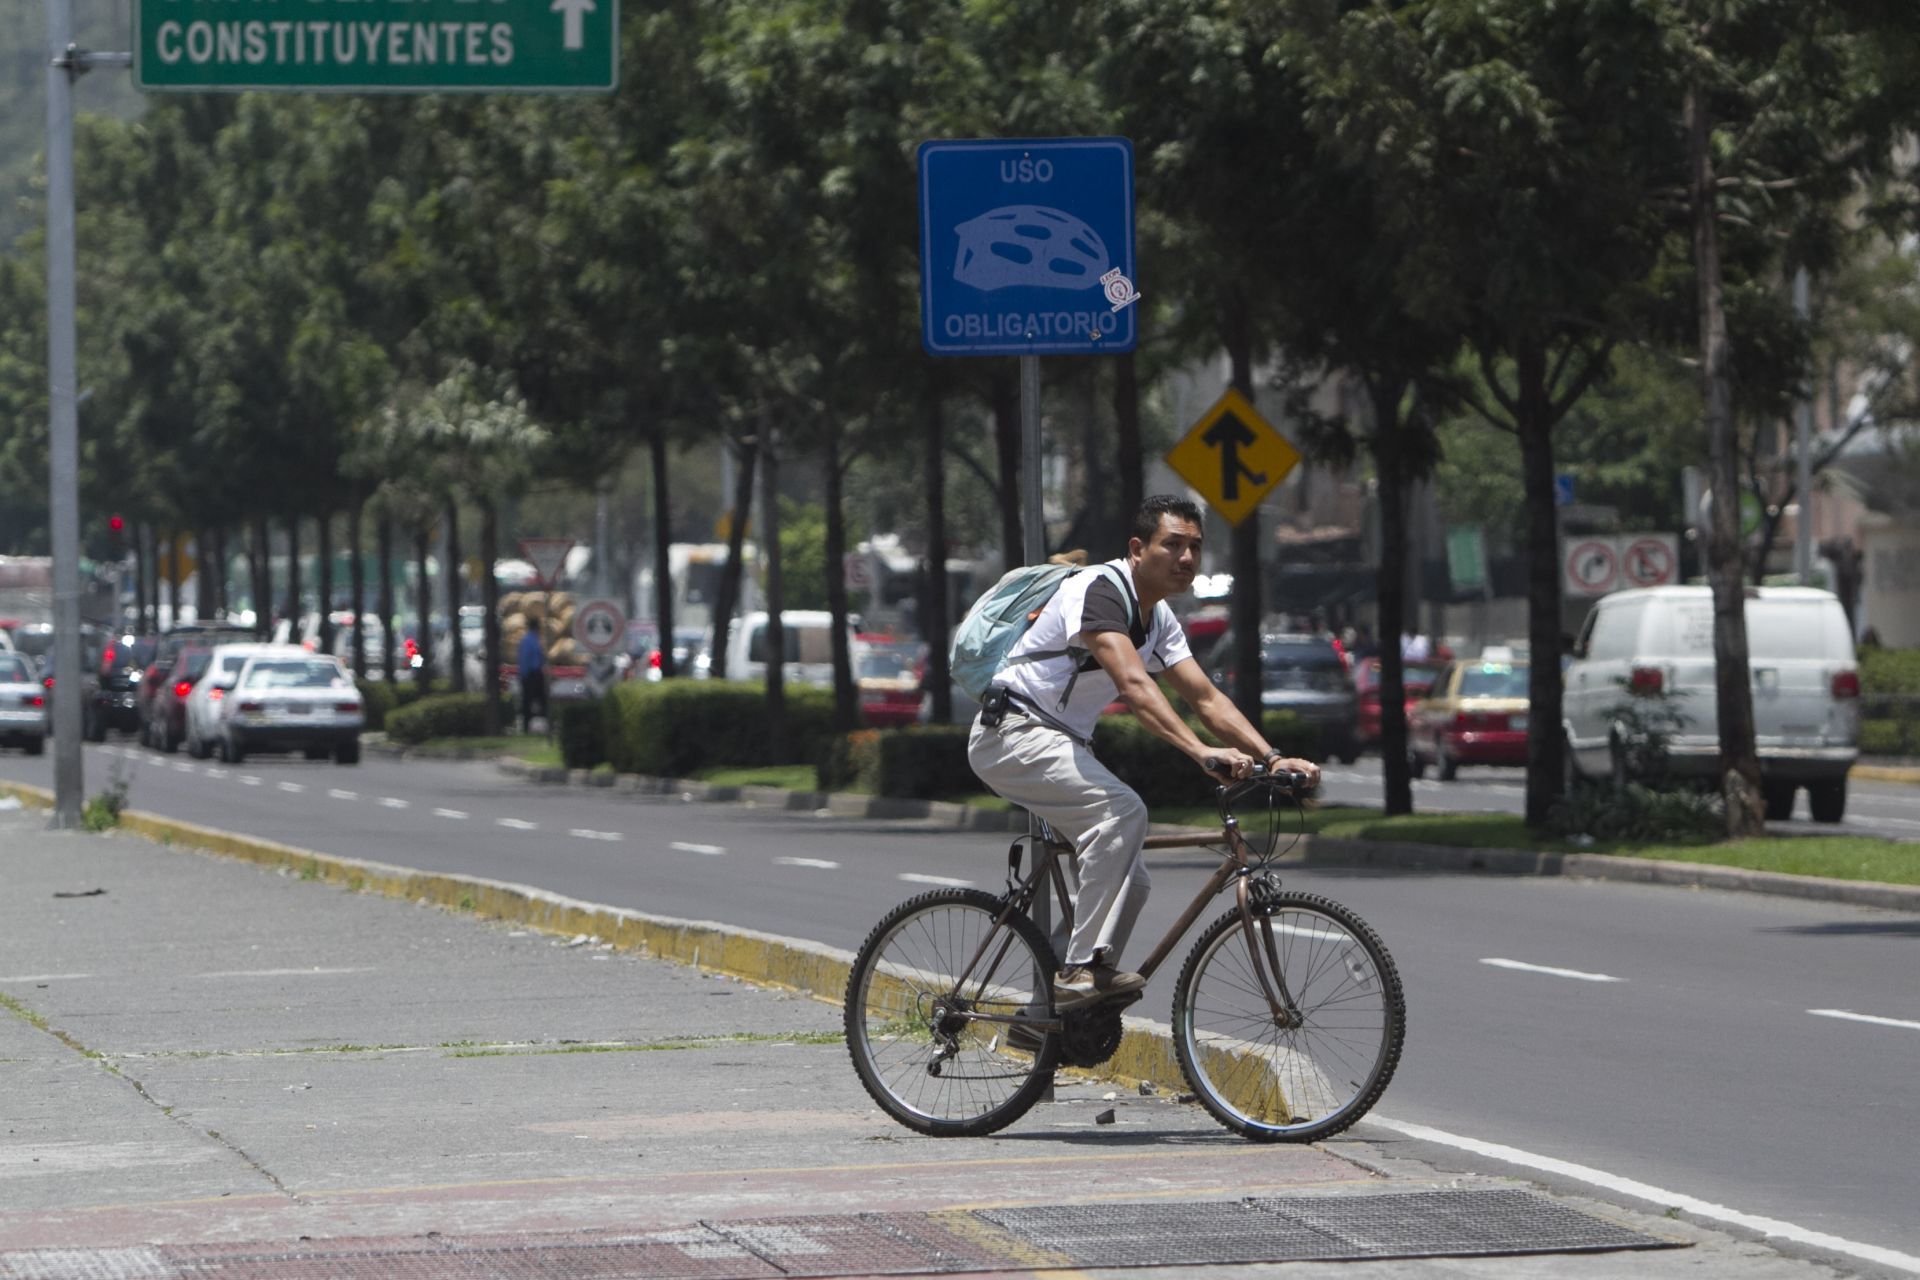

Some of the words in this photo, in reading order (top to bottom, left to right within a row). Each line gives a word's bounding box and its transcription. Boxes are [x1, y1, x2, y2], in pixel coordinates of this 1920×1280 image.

[156, 20, 514, 65] CONSTITUYENTES
[1001, 159, 1053, 183] USO
[945, 311, 1117, 338] OBLIGATORIO
